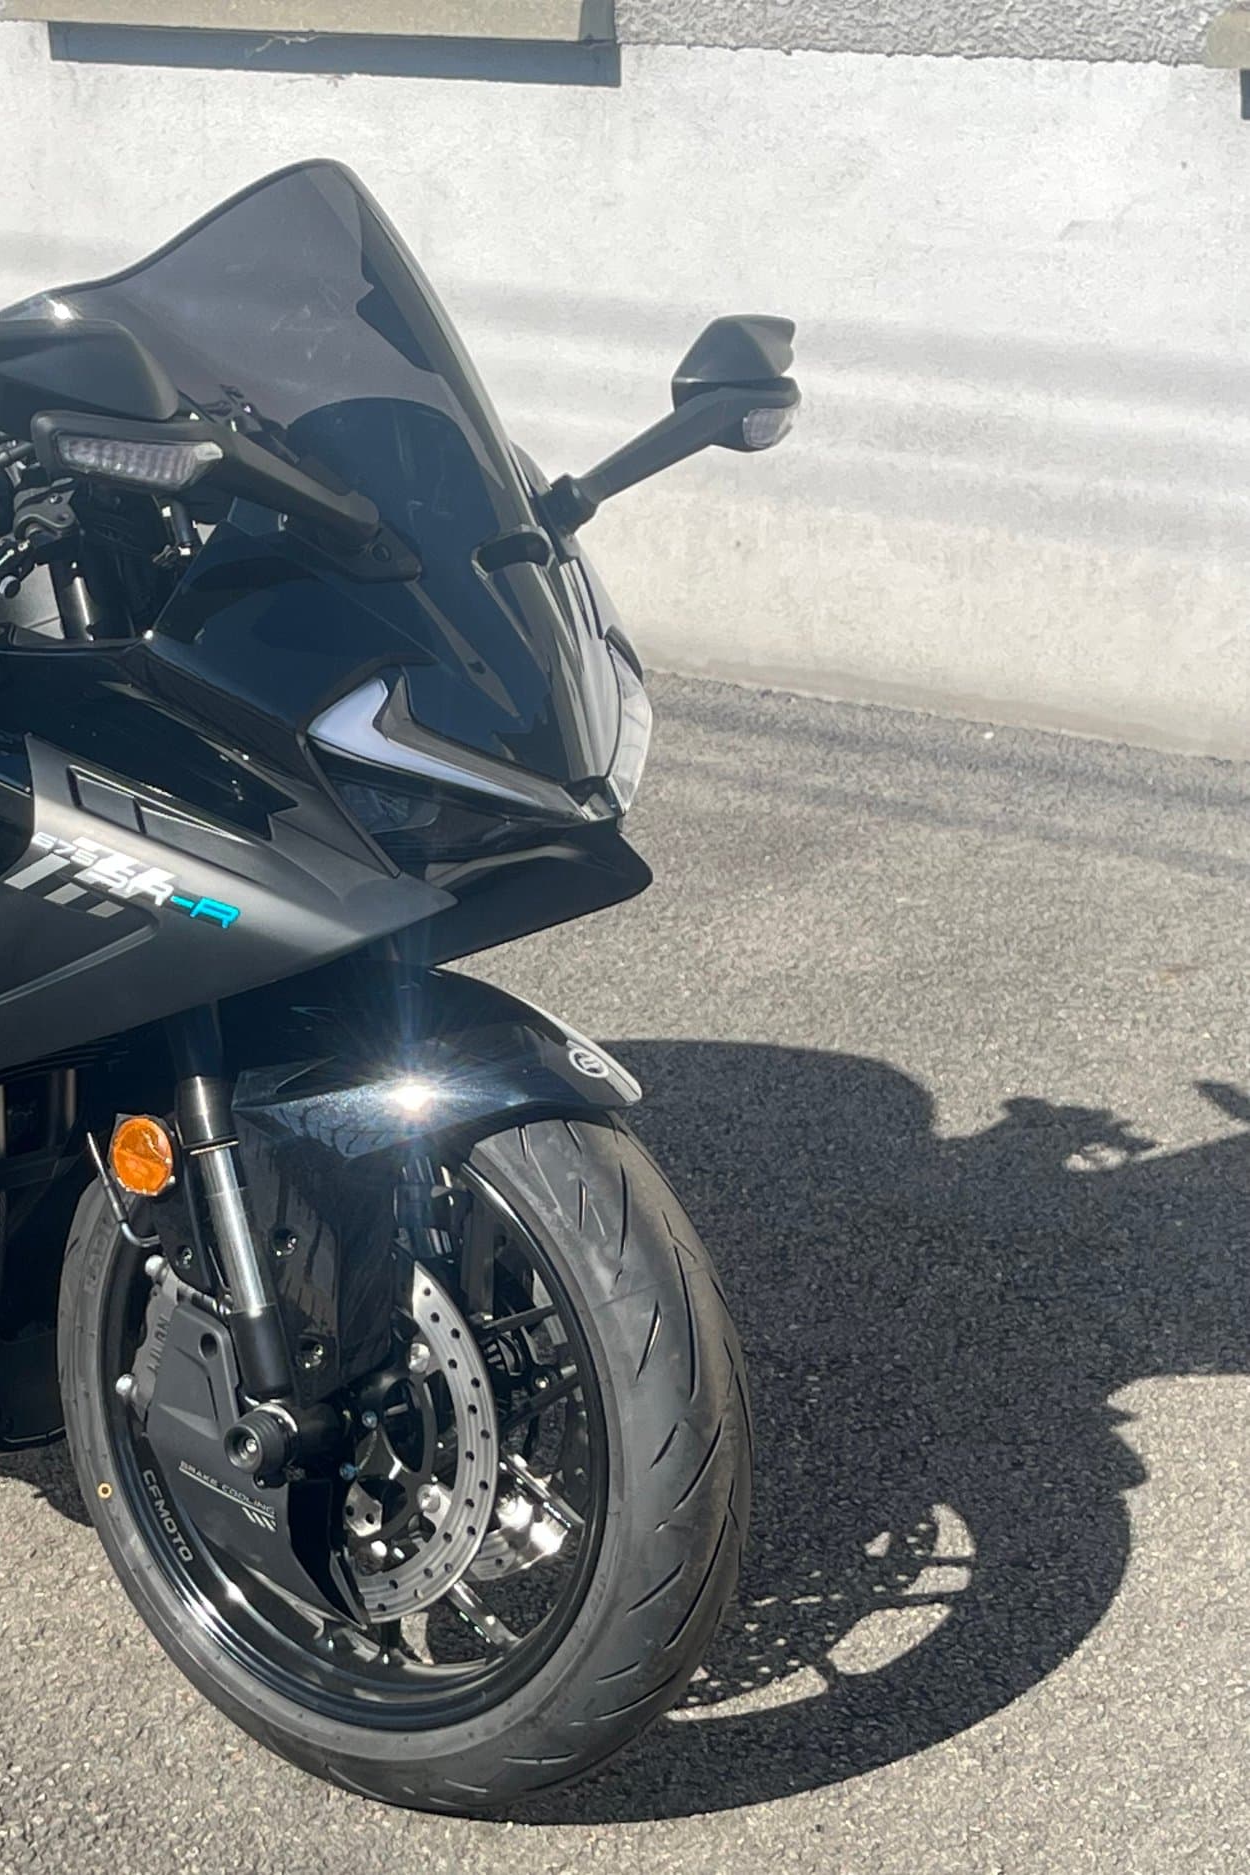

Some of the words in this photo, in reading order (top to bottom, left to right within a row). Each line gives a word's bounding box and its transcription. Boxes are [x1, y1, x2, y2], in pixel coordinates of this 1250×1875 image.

[30, 831, 100, 867] 675
[142, 1468, 194, 1563] CFMOTO
[179, 1459, 219, 1488] BRAKE
[221, 1483, 276, 1516] COOLING
